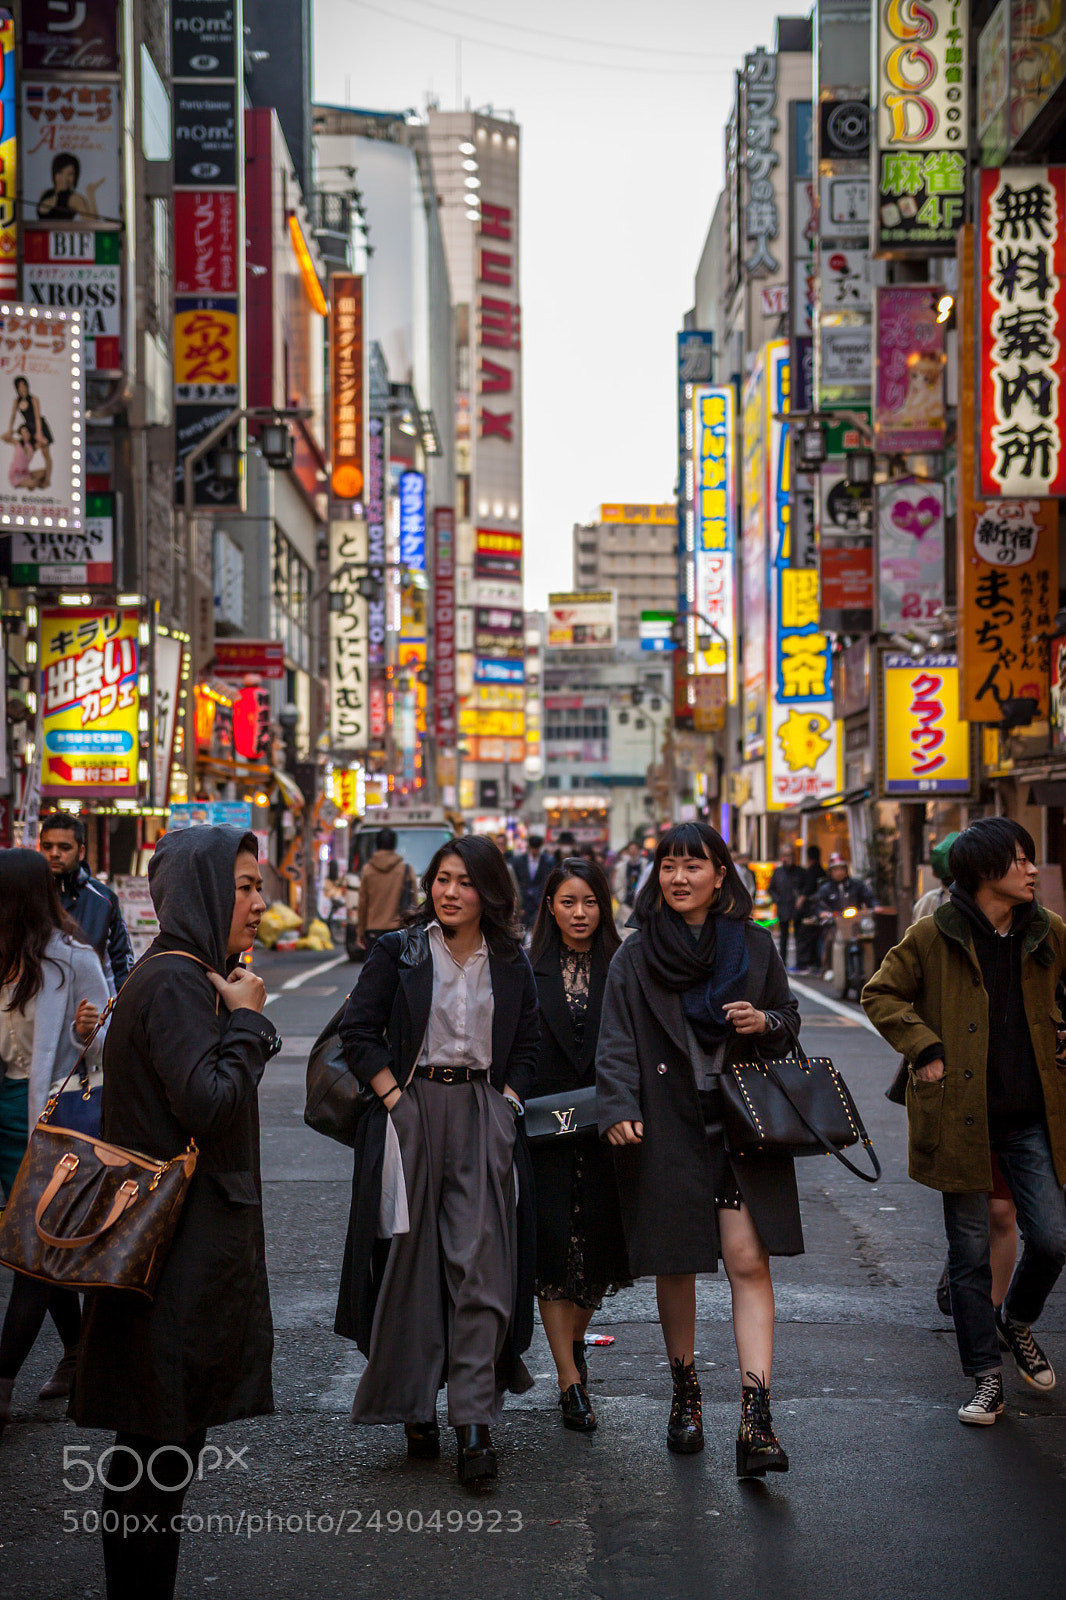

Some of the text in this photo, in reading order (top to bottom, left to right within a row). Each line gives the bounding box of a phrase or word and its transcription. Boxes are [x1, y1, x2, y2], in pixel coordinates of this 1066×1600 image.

[881, 152, 965, 195] 麻雀
[917, 196, 963, 228] 4F
[30, 283, 116, 306] XROSS
[479, 203, 521, 442] HUMAX
[995, 183, 1053, 478] 無料案内所
[0, 337, 66, 354] ッサージ
[30, 546, 94, 561] CASA
[979, 518, 1034, 550] 新宿
[997, 550, 1016, 565] の
[50, 610, 122, 655] キラリ
[975, 568, 1017, 702] まっちゃん
[47, 639, 132, 710] 出会い
[81, 682, 135, 725] カフェ
[910, 673, 945, 774] クラウン
[774, 776, 833, 793] マンボー
